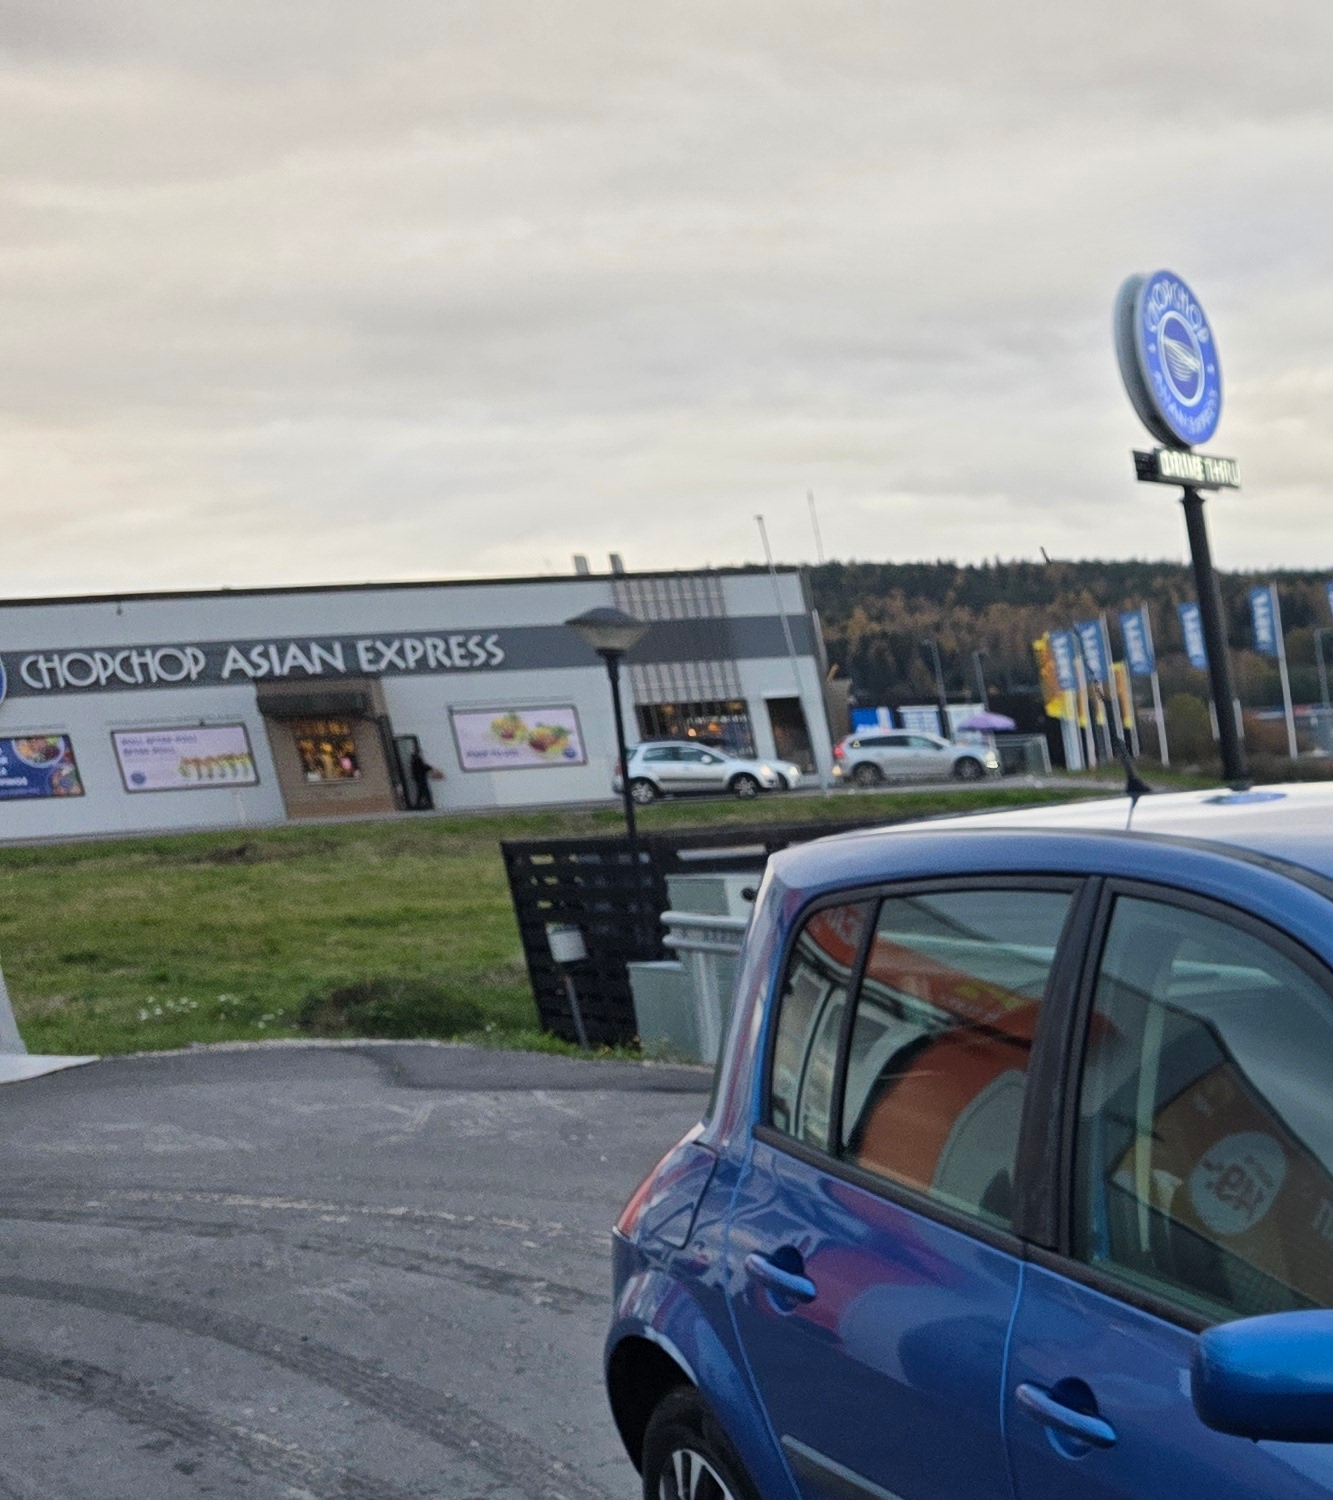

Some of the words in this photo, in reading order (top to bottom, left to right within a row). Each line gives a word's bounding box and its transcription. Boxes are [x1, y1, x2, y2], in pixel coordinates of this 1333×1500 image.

[20, 646, 206, 690] CHOPCHOP
[221, 640, 346, 679] ASIAN
[355, 634, 505, 673] EXPRESS
